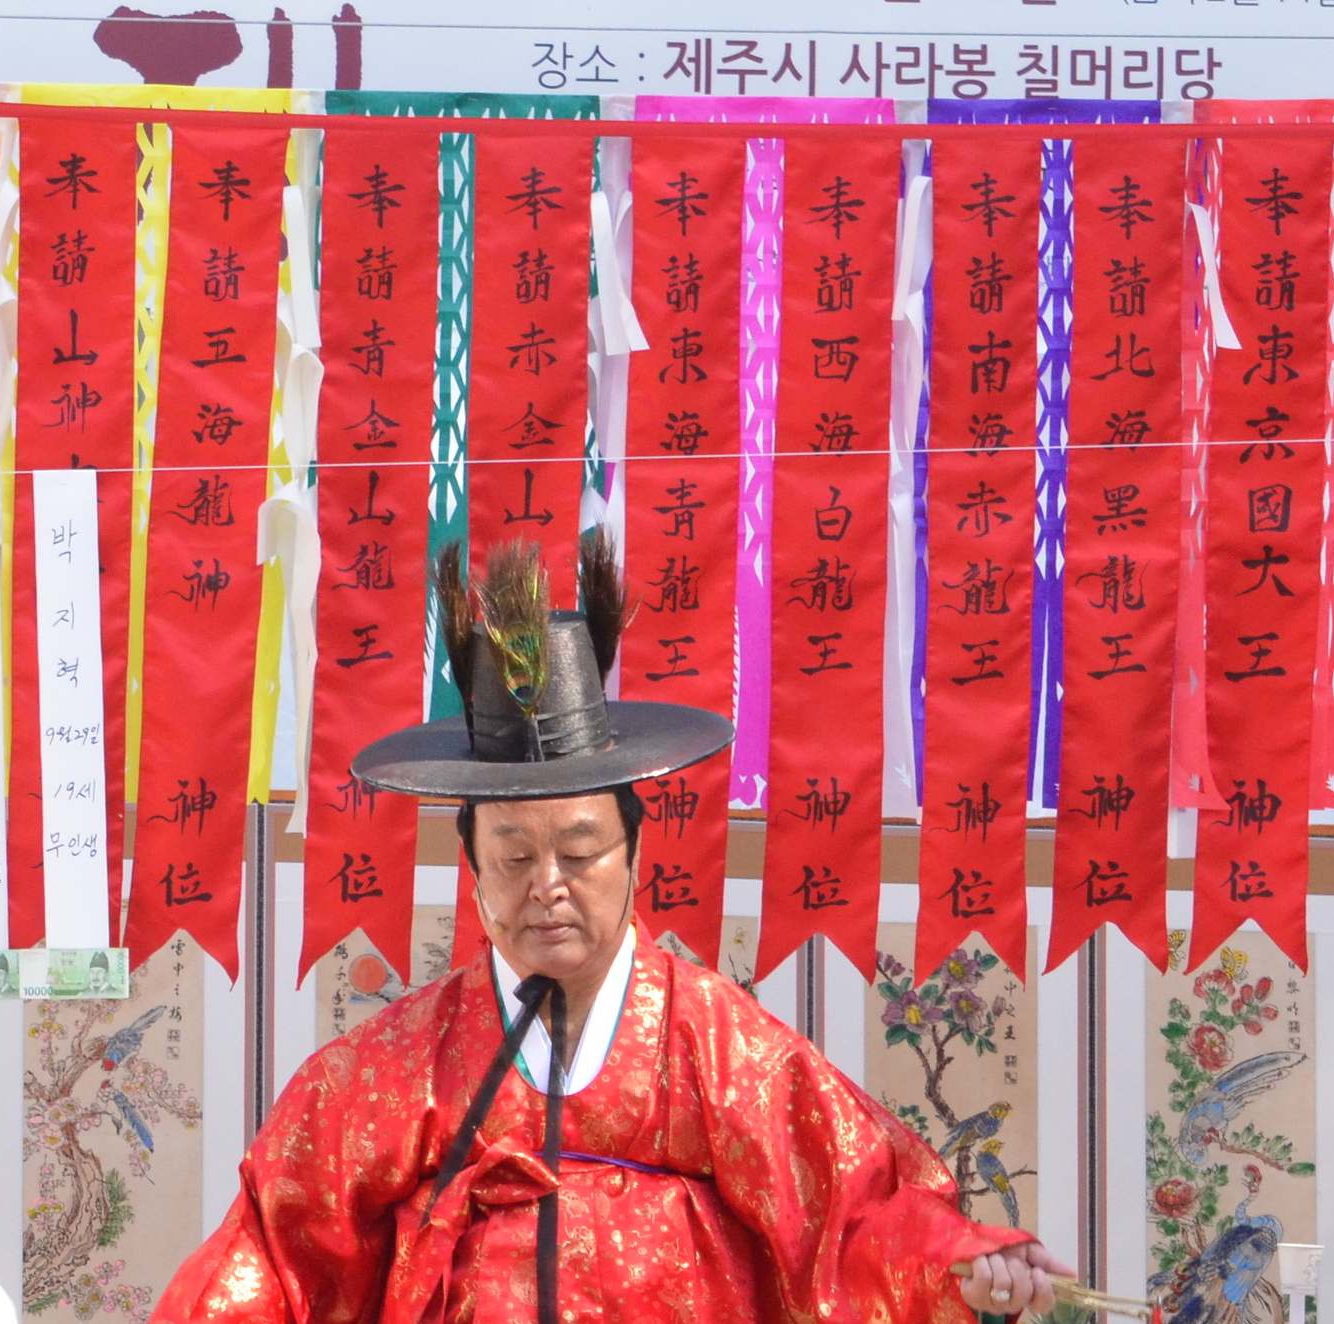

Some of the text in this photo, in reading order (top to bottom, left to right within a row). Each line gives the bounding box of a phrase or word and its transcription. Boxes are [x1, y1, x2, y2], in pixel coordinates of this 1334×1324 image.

[531, 42, 621, 90] 장소
[663, 37, 818, 97] 제주시
[838, 41, 997, 99] 사라봉
[1014, 44, 1225, 100] 칠머리당
[50, 518, 81, 690] 박지혁
[53, 780, 97, 804] 19세
[46, 832, 99, 858] 무인생
[24, 985, 54, 997] 10000
